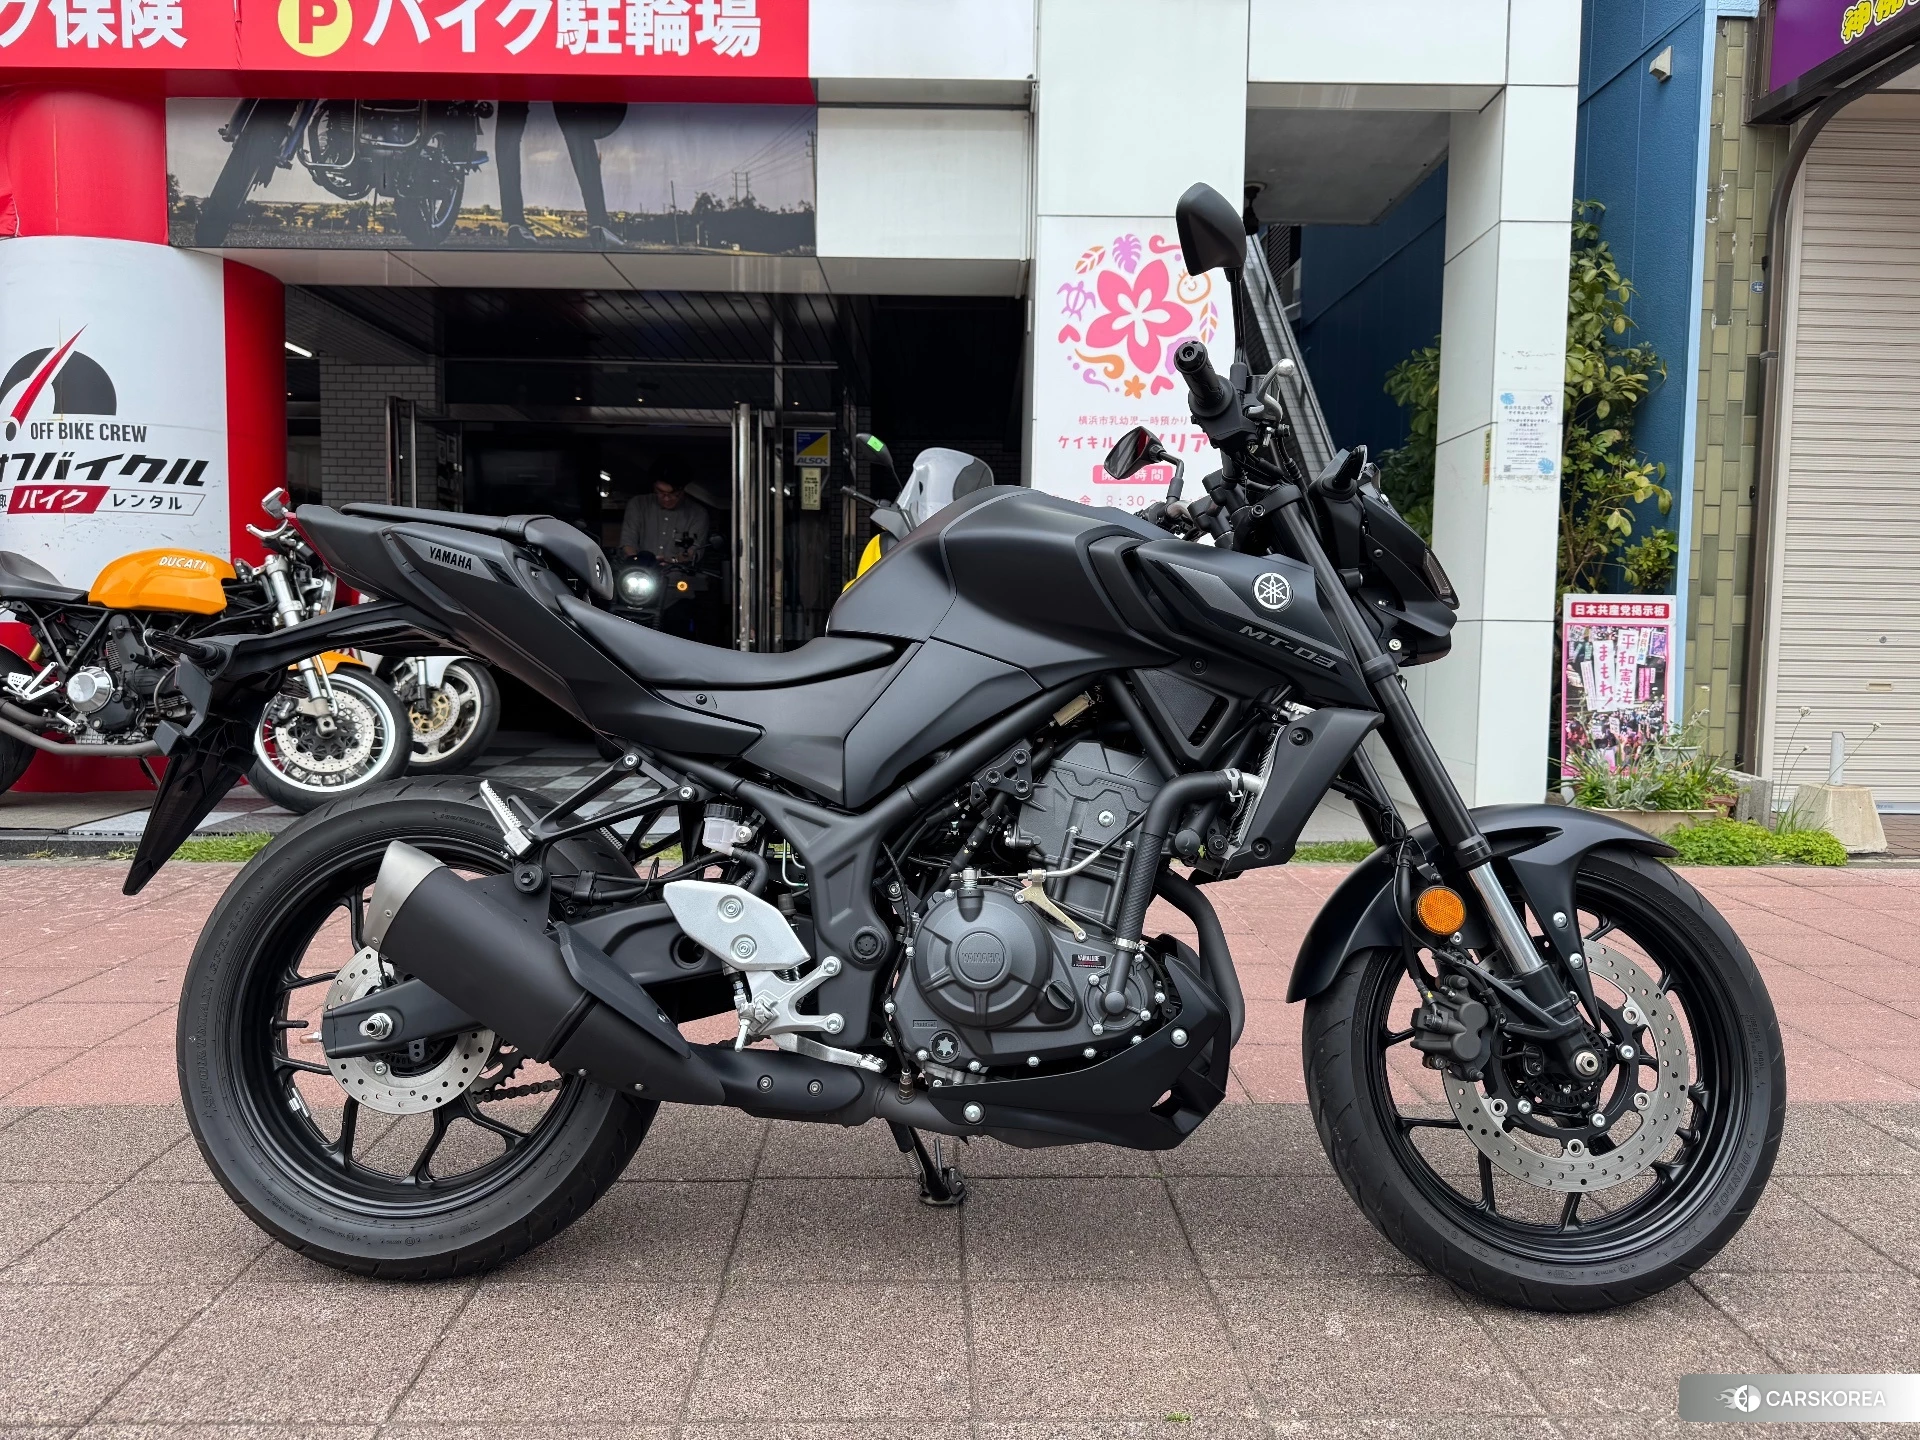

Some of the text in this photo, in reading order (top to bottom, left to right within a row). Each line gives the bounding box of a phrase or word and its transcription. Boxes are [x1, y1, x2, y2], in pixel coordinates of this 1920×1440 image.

[298, 0, 762, 58] P バイク駐輪場
[1078, 415, 1188, 426] 横浜市乳幼児一時預かり
[31, 422, 148, 443] OFF BIKE CREW
[18, 489, 88, 510] バイク
[113, 493, 183, 511] レンタル
[158, 555, 207, 570] DUCATI
[429, 545, 472, 571] YAMAHA
[1575, 604, 1666, 617] 日本共産党掲示板
[1239, 625, 1338, 669] MT-03
[1617, 633, 1635, 705] 平和憲法
[961, 952, 1001, 964] YAMAHA
